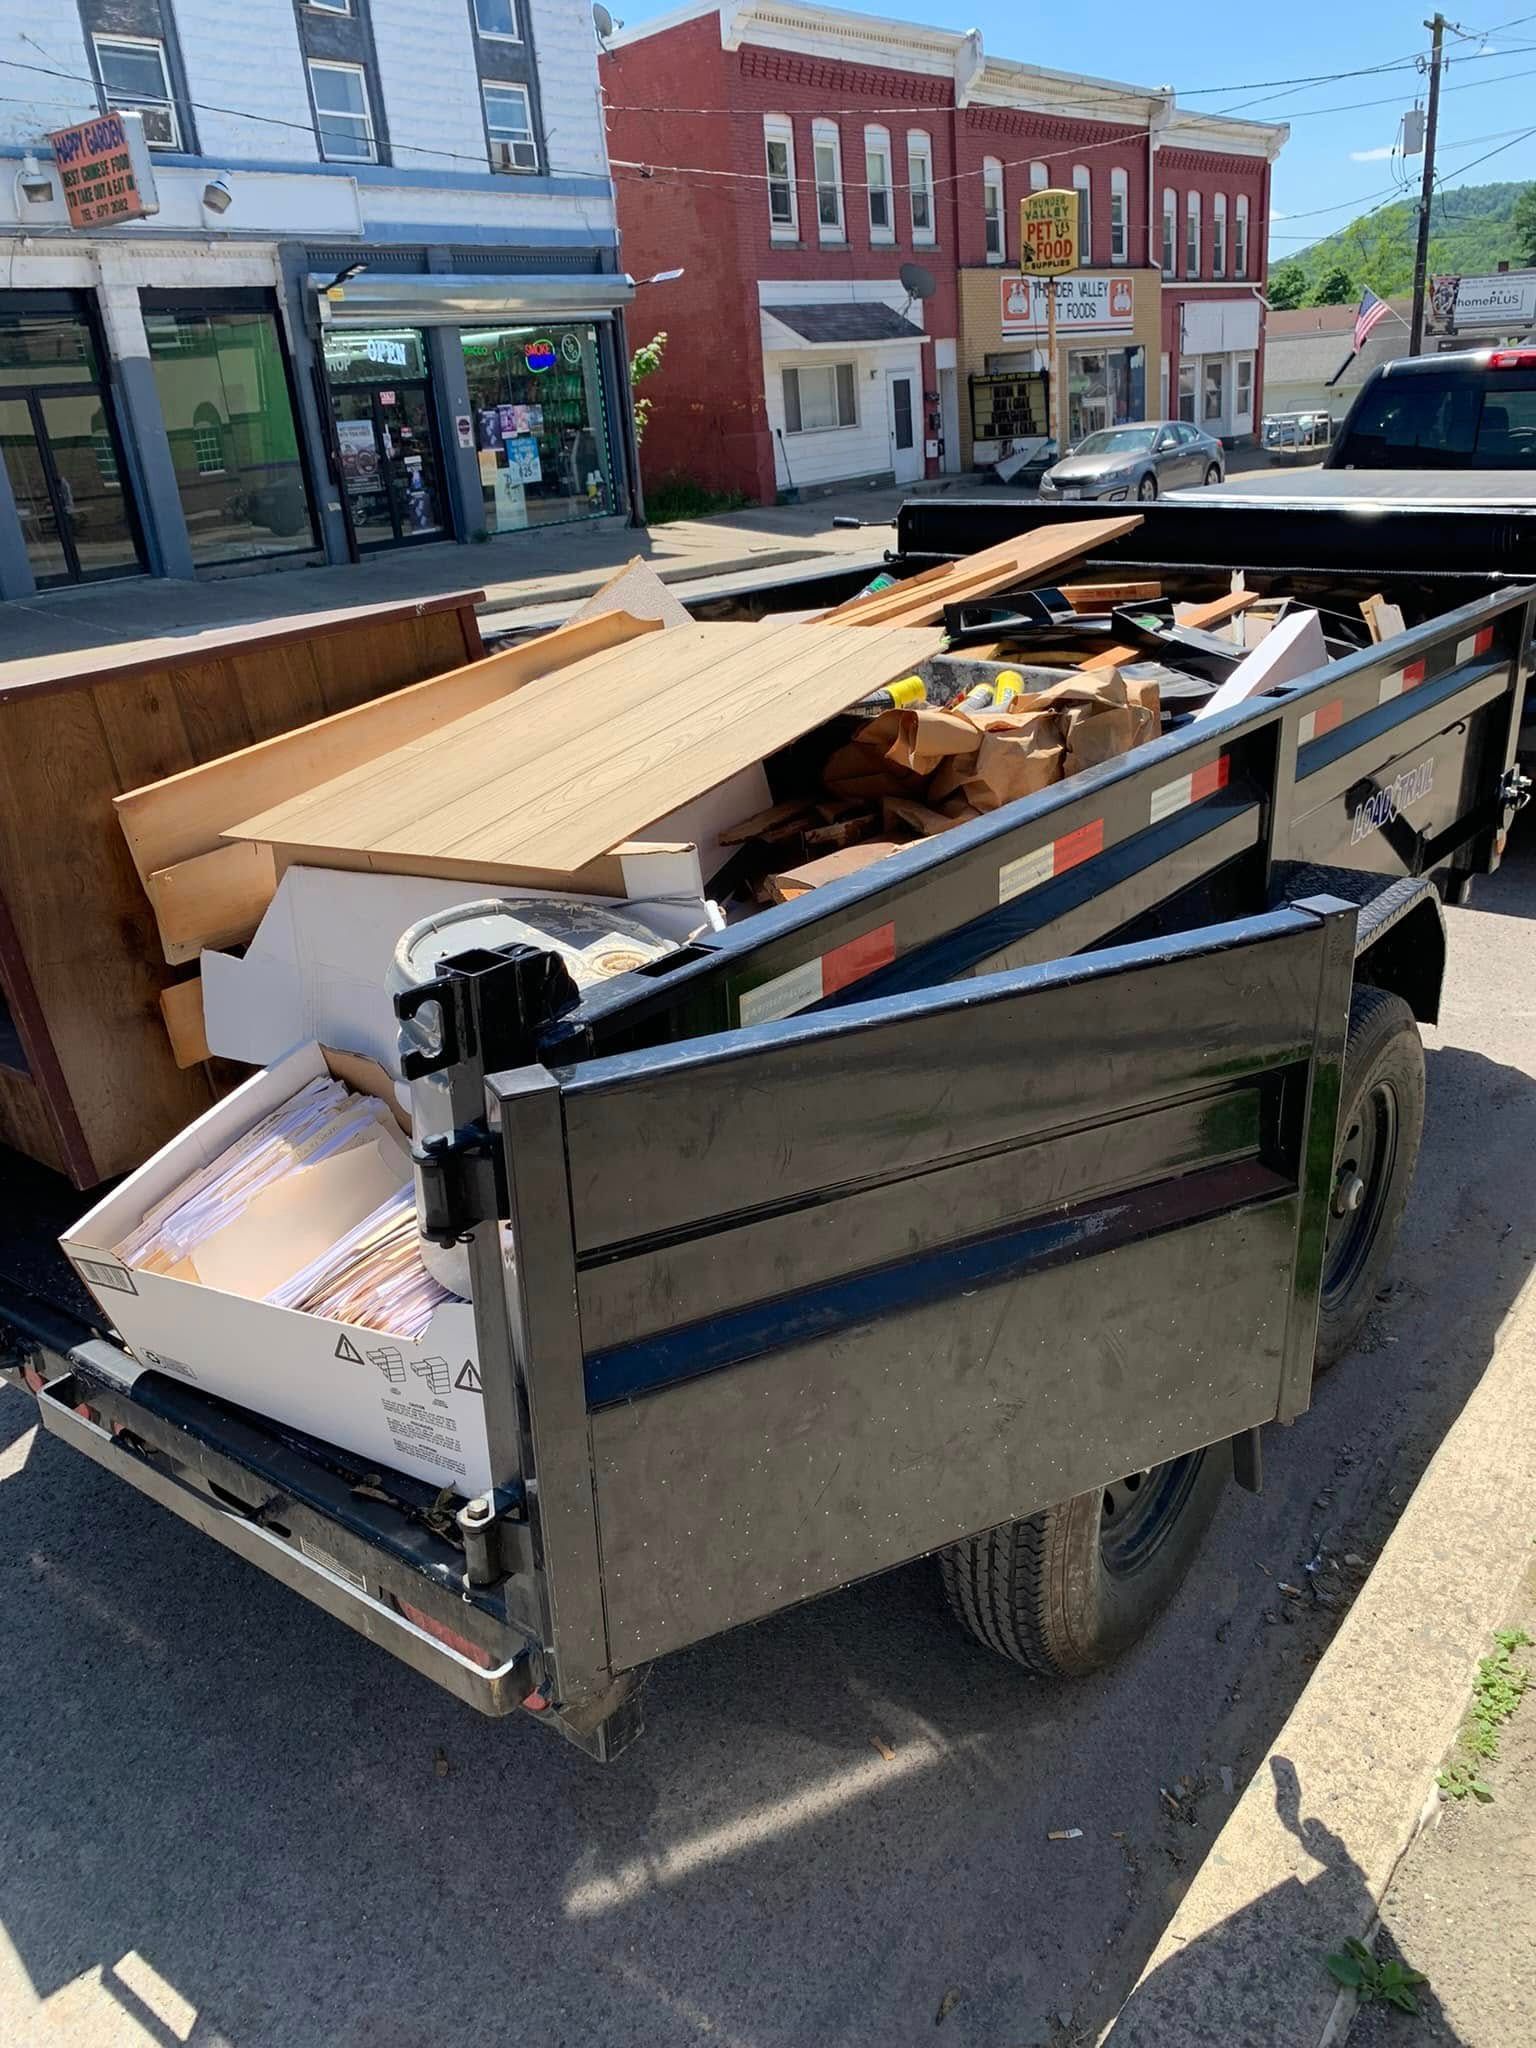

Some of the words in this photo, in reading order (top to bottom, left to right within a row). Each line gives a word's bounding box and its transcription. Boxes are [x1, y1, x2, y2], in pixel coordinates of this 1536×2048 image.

[53, 130, 86, 165] HAPPY
[84, 118, 126, 156] GARDEN
[62, 168, 80, 188] BEST
[80, 159, 110, 183] CHINESE
[110, 154, 129, 173] FOOD
[68, 191, 78, 207] TO
[77, 186, 94, 205] TAKE
[93, 182, 107, 201] OUT
[113, 176, 126, 194] EAT
[1028, 195, 1066, 209] THUNDER
[1024, 206, 1069, 220] VALLEY
[1027, 221, 1052, 241] PET
[1036, 239, 1073, 261] FOOD
[1031, 259, 1071, 270] SUPPLIES
[1032, 281, 1074, 300] THUDER
[1078, 281, 1109, 298] VALLEY
[1457, 294, 1520, 307] homePLUS
[1045, 303, 1063, 320] PT
[1067, 303, 1096, 319] FOODS
[367, 339, 407, 366] OPEN
[524, 343, 550, 356] SMOKE
[1351, 784, 1393, 847] LOAD
[1398, 757, 1435, 811] TRAIL
